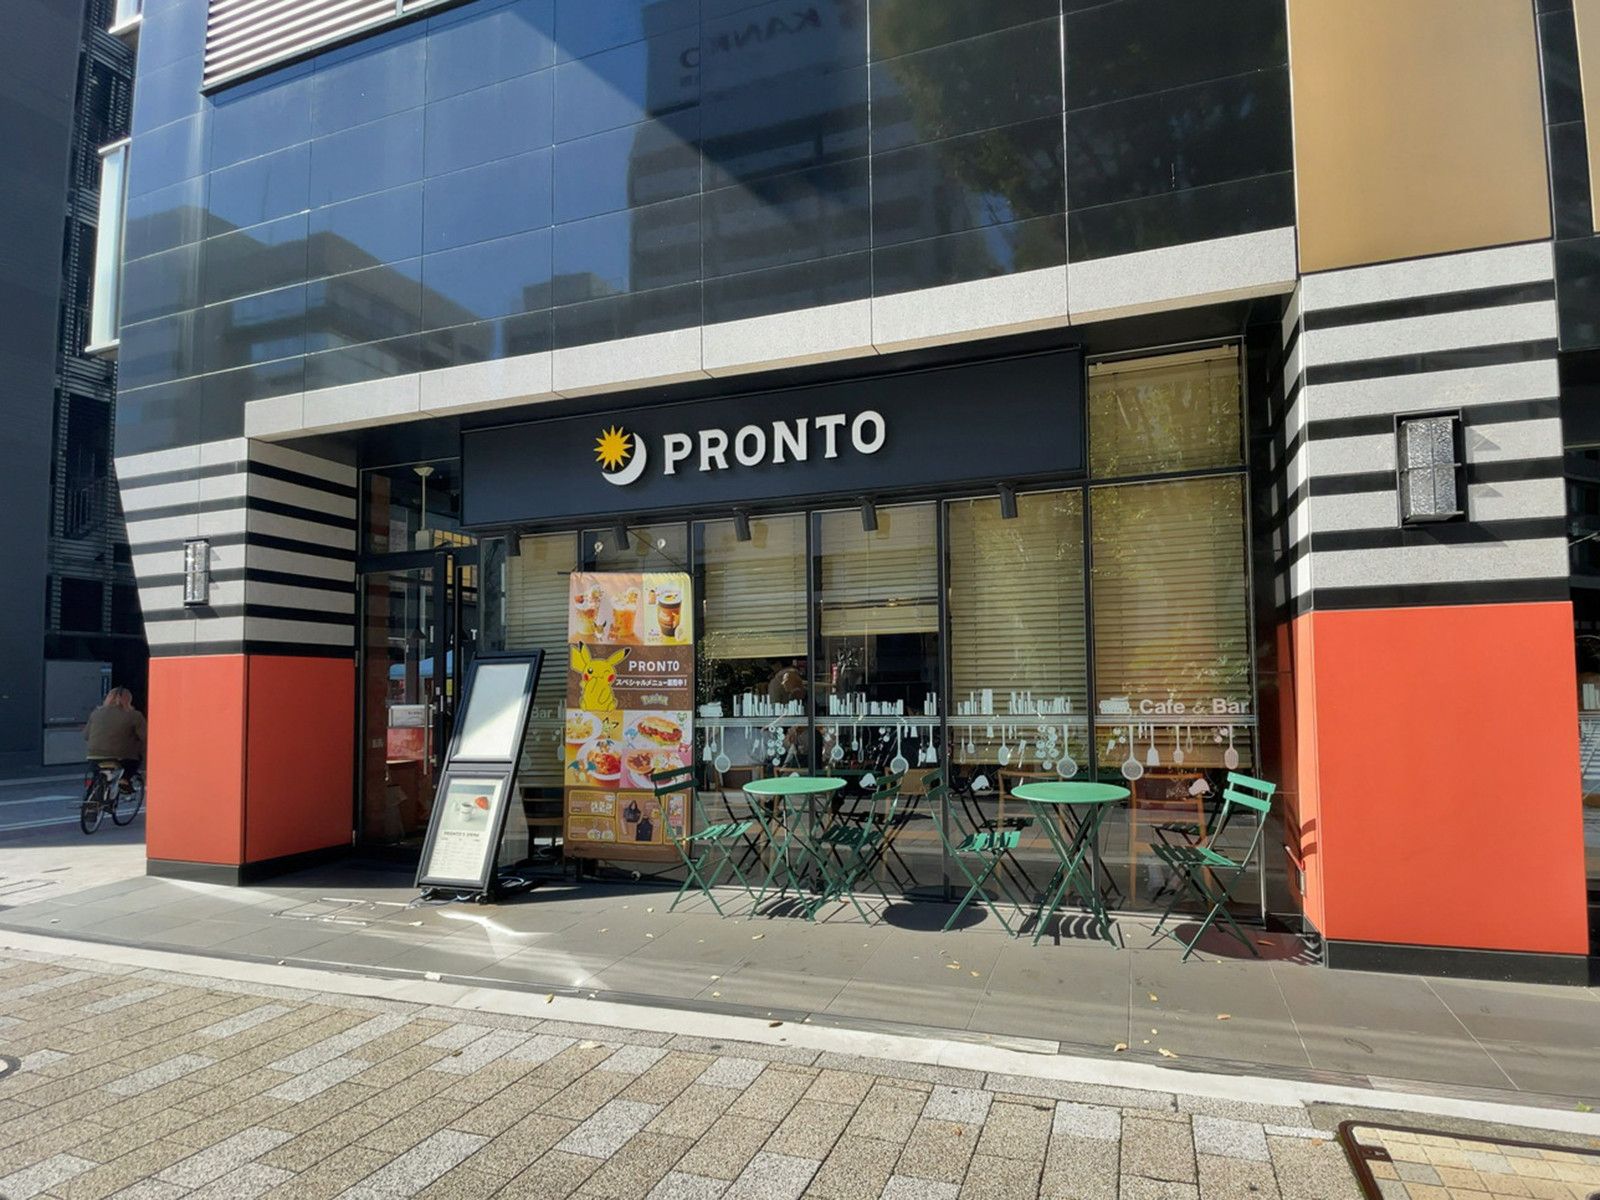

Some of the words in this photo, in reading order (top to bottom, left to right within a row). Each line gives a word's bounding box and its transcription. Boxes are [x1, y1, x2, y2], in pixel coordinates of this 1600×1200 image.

[663, 410, 886, 475] PRONTO
[628, 660, 680, 672] PRONTO
[1139, 699, 1186, 714] Cafe
[1192, 702, 1205, 714] &
[1212, 698, 1250, 714] Bar
